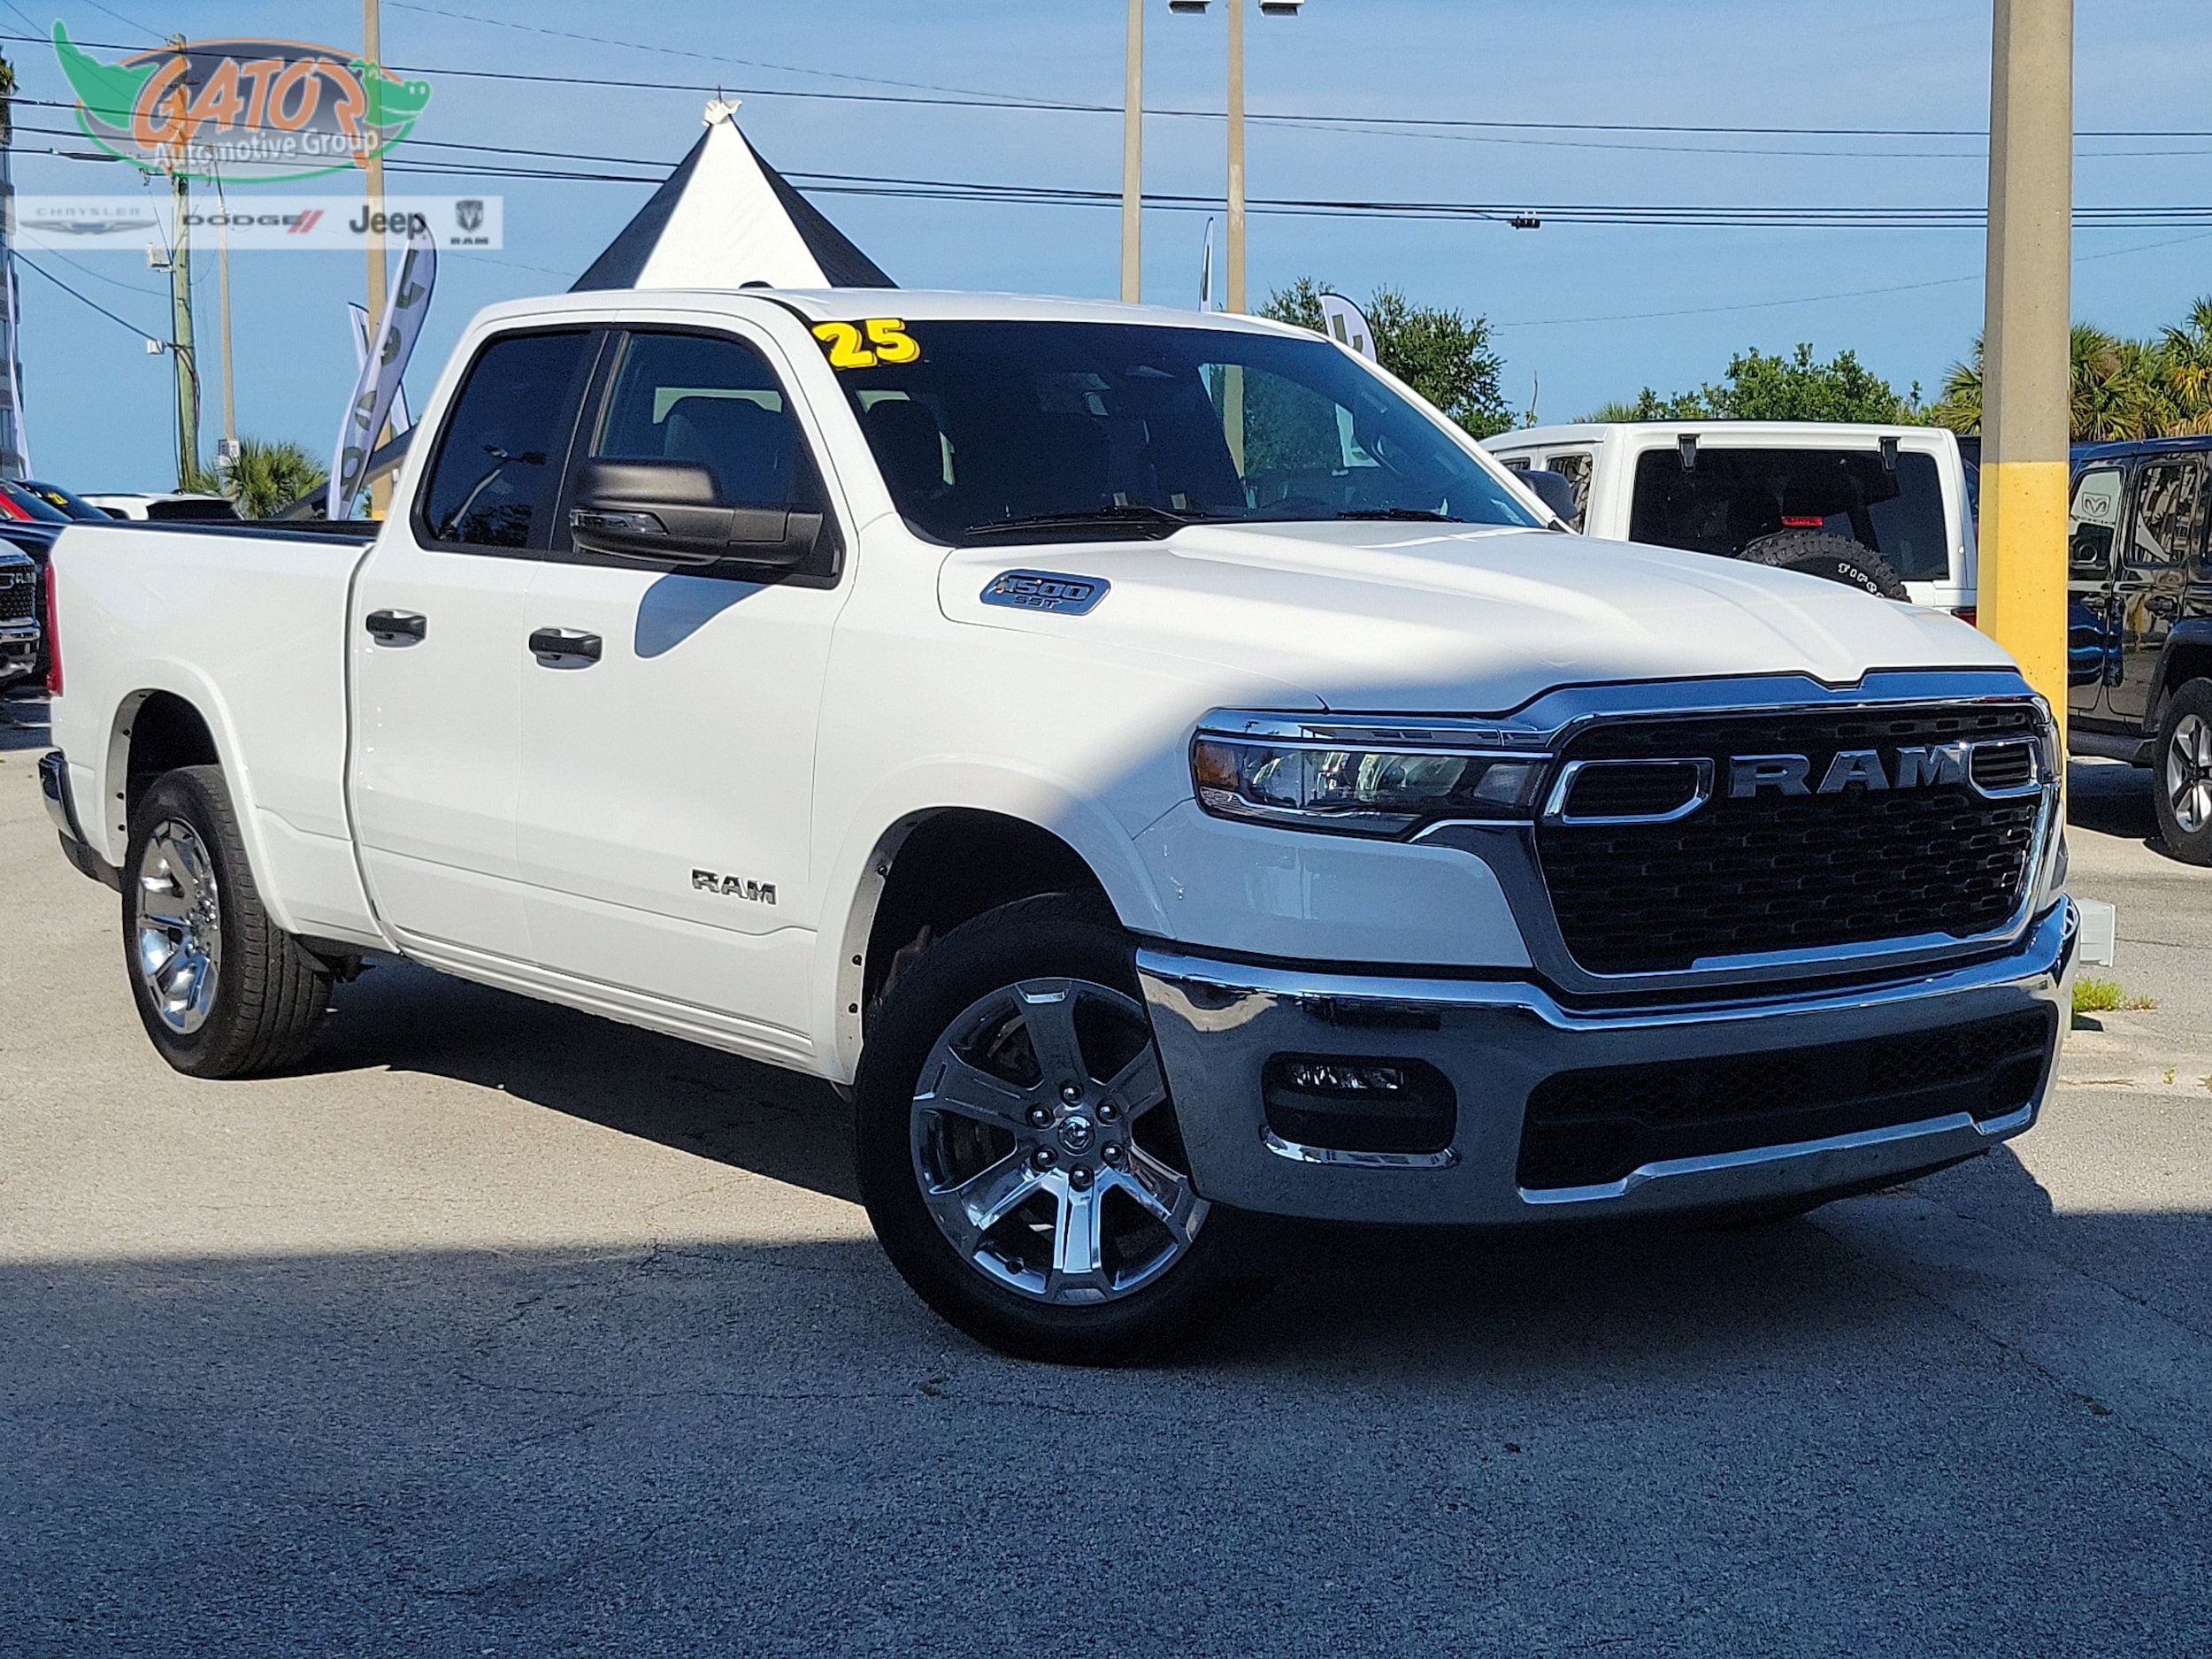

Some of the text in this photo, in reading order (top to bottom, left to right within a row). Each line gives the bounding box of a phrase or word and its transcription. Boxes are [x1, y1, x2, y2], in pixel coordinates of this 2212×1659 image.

[811, 318, 921, 369] 25
[1006, 577, 1091, 600] 1500
[1728, 743, 1966, 797] RAM
[692, 869, 777, 905] RAM
